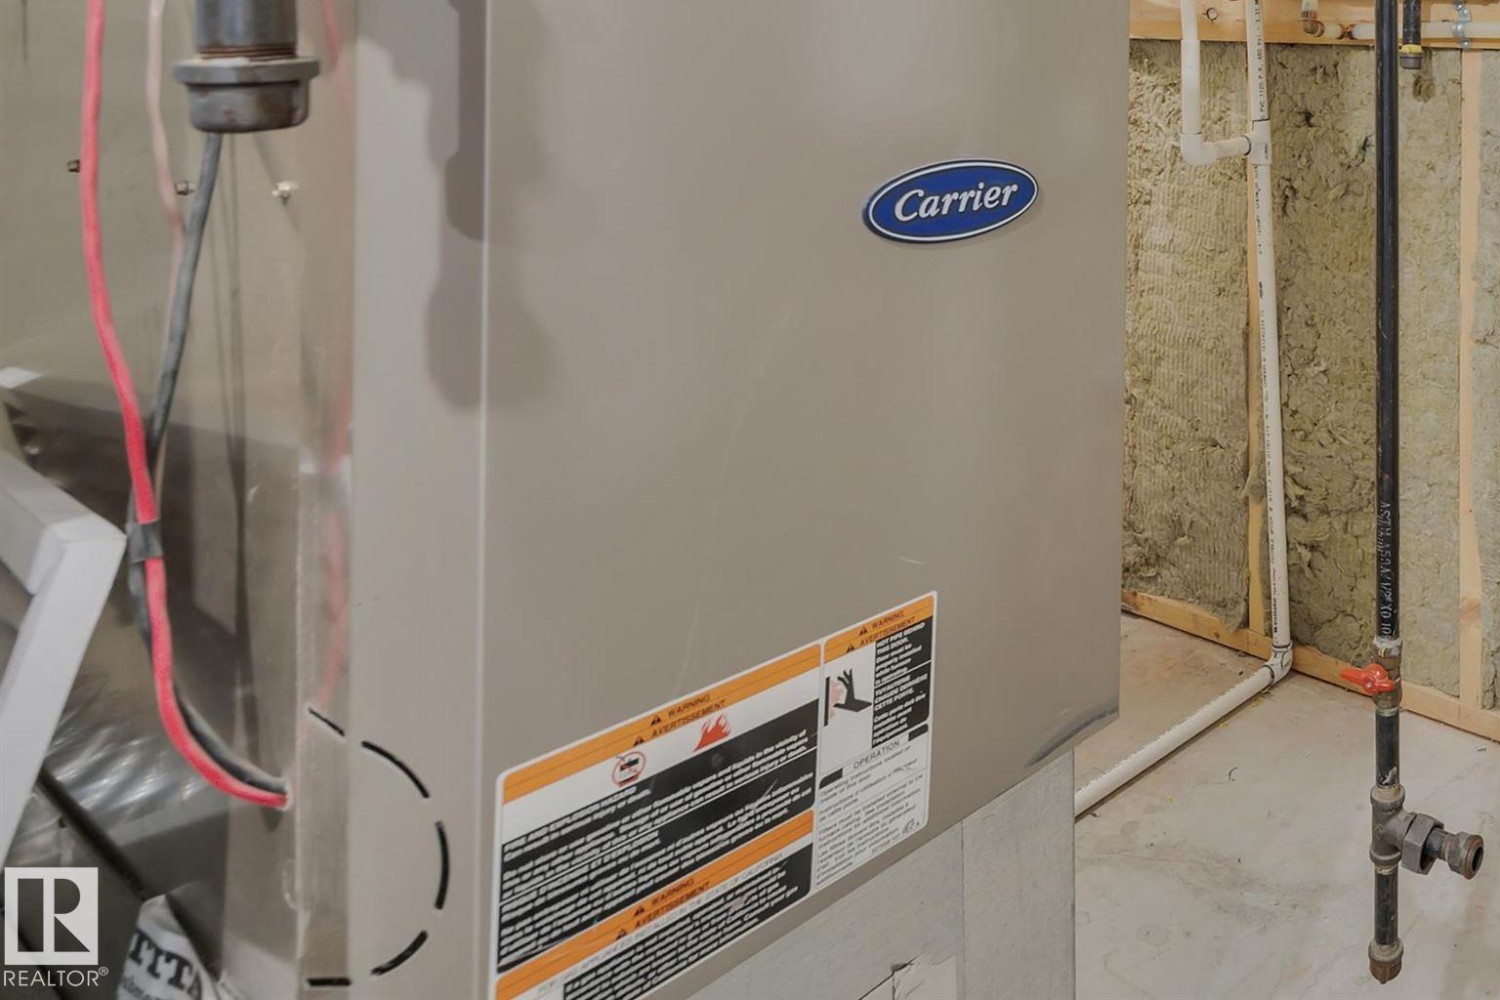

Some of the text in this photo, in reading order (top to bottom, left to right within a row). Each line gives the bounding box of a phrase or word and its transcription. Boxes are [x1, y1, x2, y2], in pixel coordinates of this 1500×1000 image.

[894, 181, 1019, 223] Carrier
[859, 616, 916, 647] AVERTISSEMENT
[872, 610, 905, 630] WARNING
[650, 699, 726, 740] AVERTISSEMENT
[667, 693, 712, 718] WARNING
[853, 741, 900, 769] OPERATION
[633, 880, 712, 930] AVERTISSEMENT
[650, 876, 696, 907] WARNING
